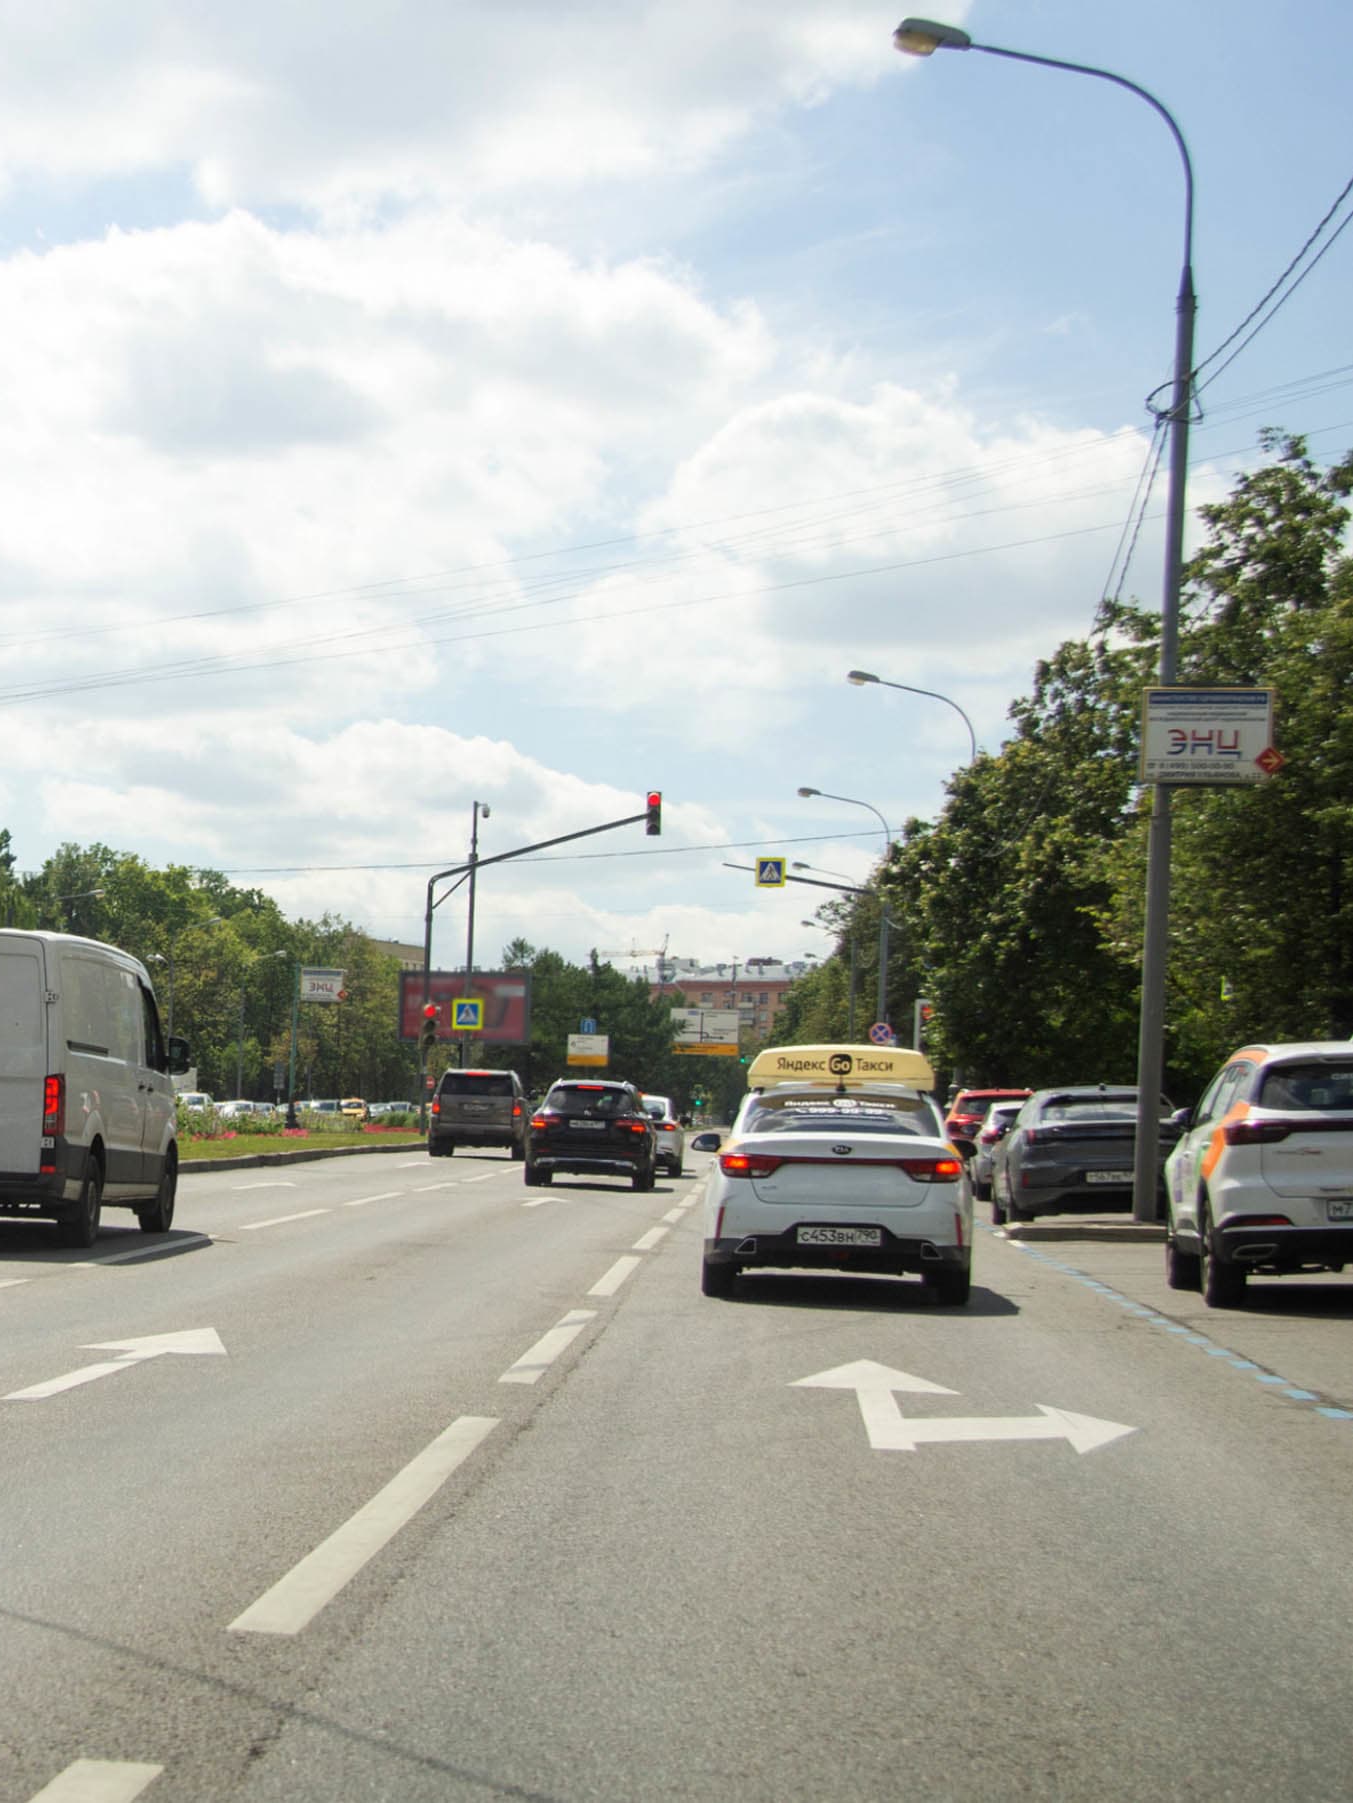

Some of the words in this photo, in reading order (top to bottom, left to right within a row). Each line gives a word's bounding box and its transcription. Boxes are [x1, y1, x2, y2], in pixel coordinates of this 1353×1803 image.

[1166, 728, 1243, 760] ЭНЦ
[776, 1057, 827, 1073] Яндекс
[831, 1058, 851, 1071] Go
[855, 1057, 894, 1072] Такси
